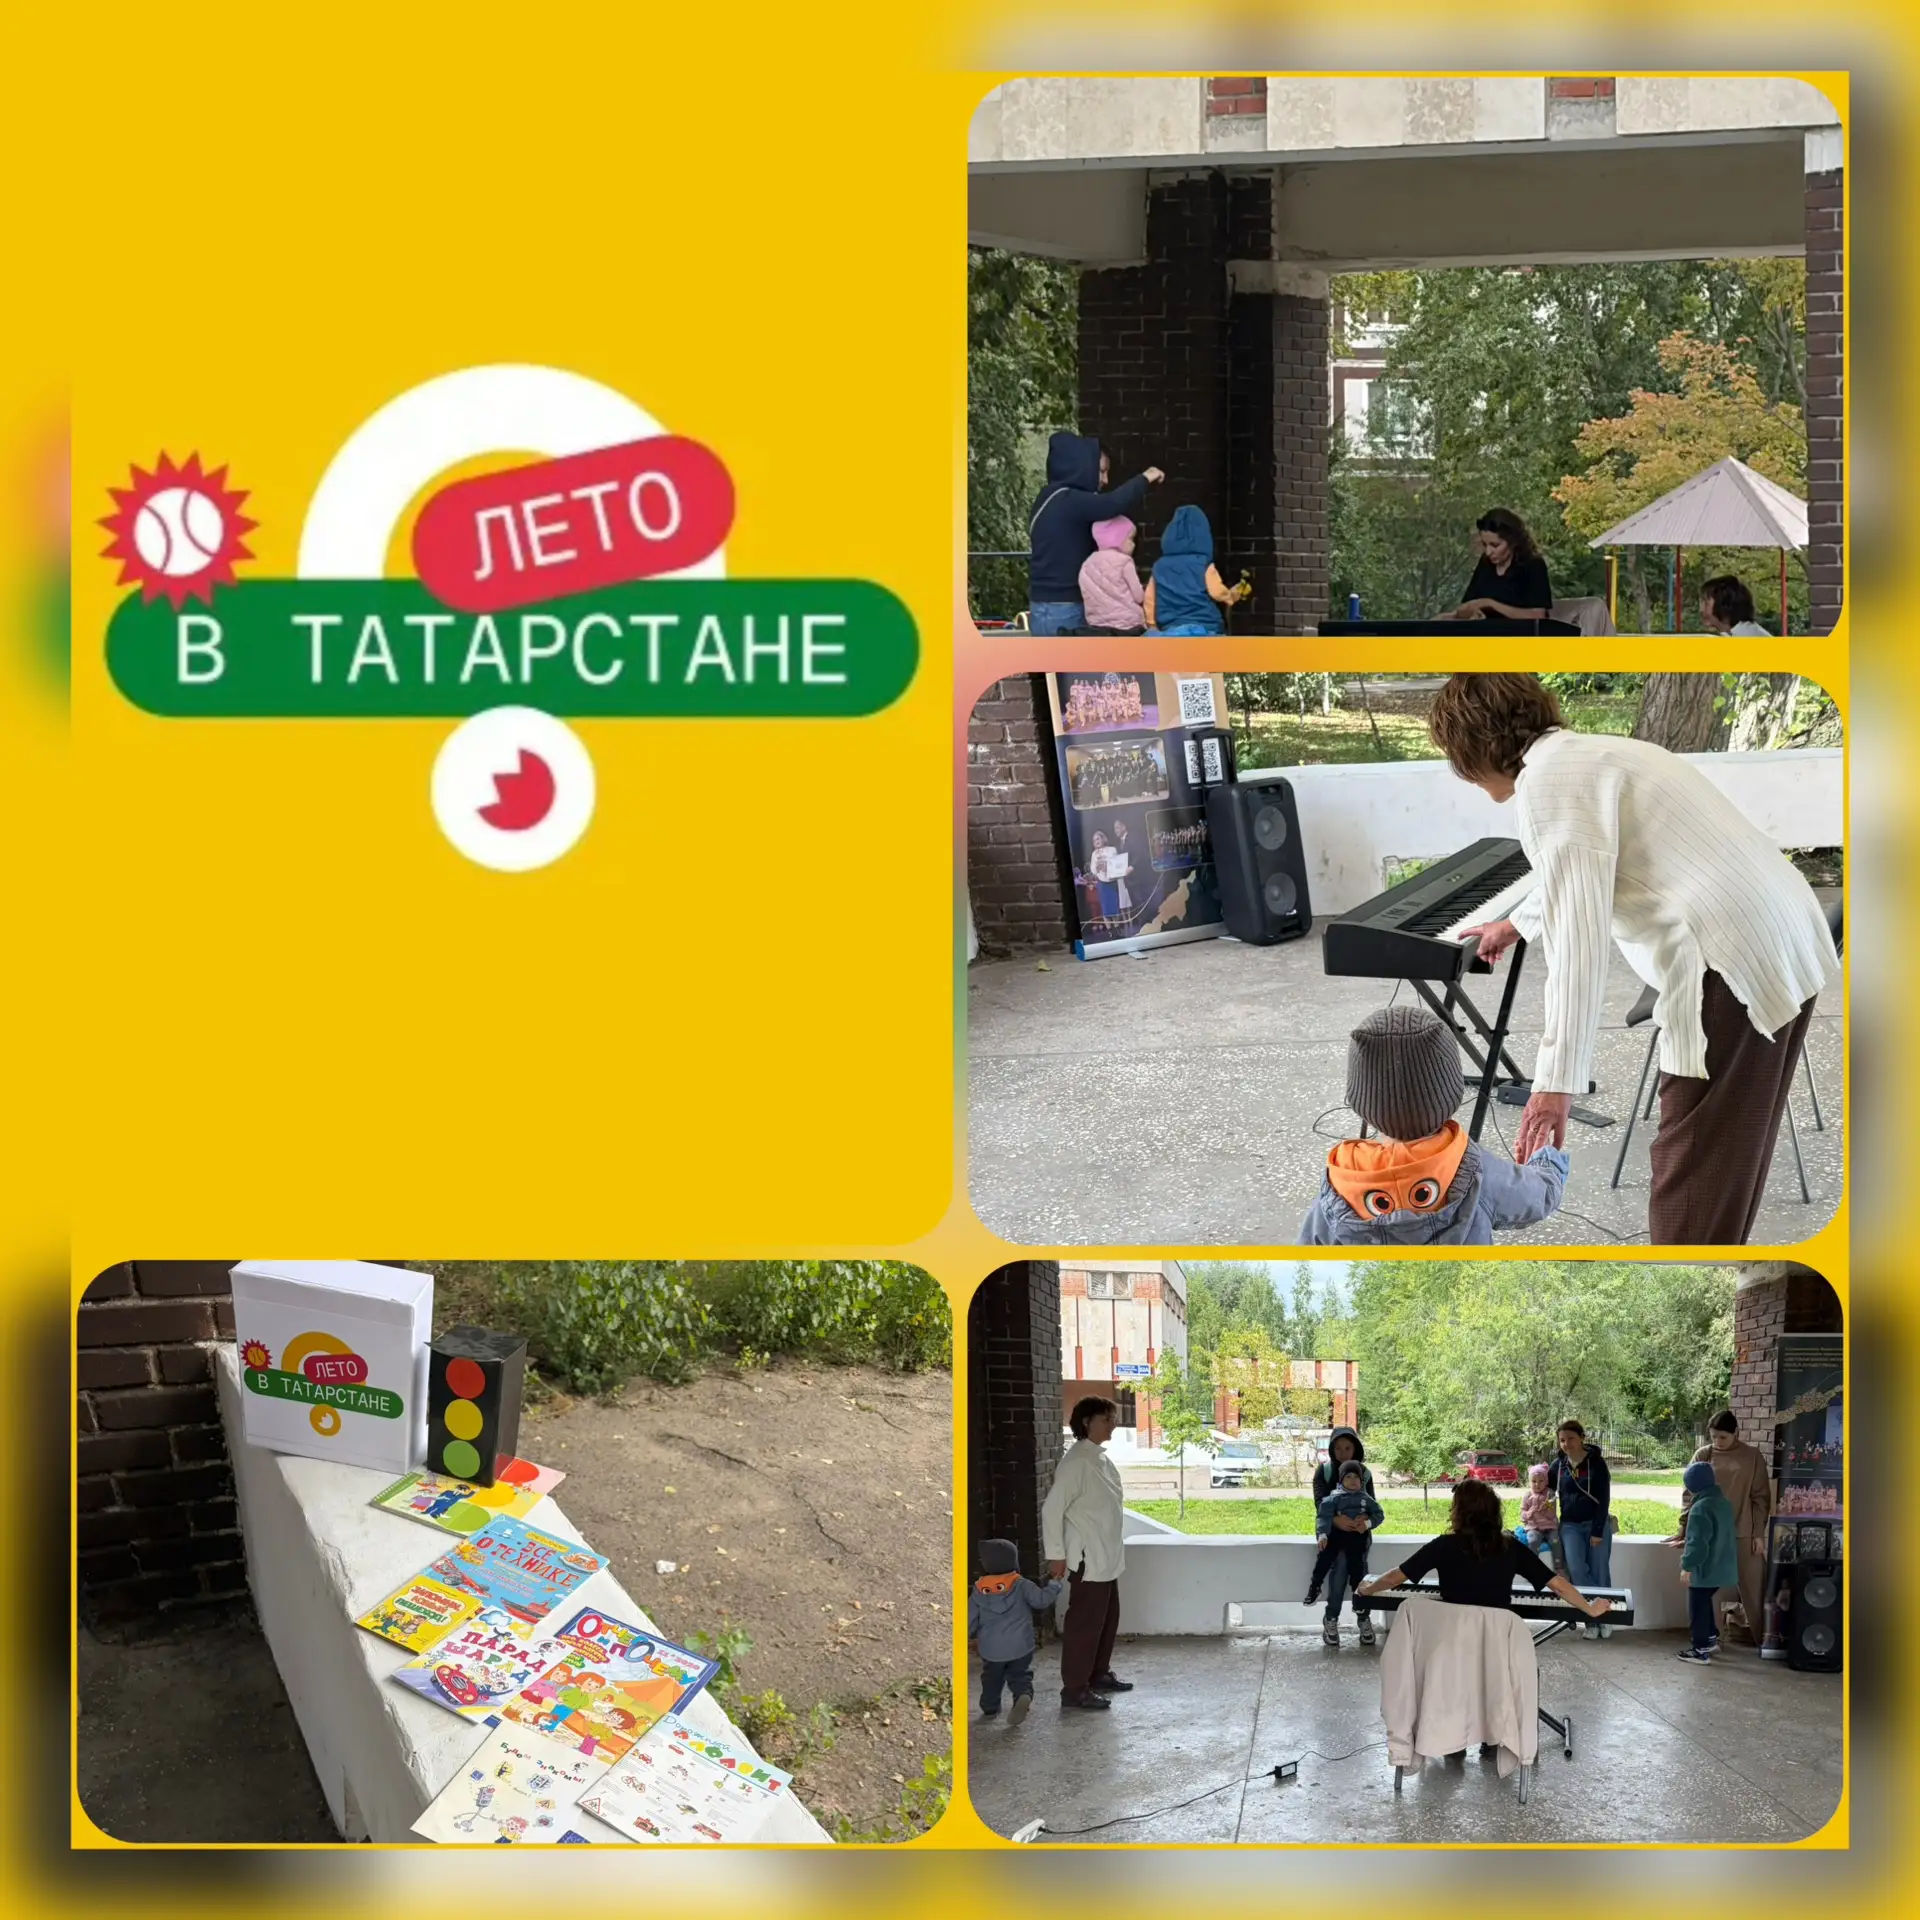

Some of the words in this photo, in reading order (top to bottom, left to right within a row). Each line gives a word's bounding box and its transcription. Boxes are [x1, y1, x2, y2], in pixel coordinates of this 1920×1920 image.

[315, 1360, 358, 1379] ЛЕТО
[257, 1373, 269, 1389] В
[280, 1377, 391, 1412] ТАТАРСТАНЕ
[476, 1537, 494, 1549] О
[491, 1543, 580, 1588] ТЕХНИКЕ
[442, 1641, 531, 1684] ШАРАД
[461, 1631, 547, 1673] ПАРАД
[664, 1715, 731, 1752] Дорожный
[500, 1742, 531, 1760] Будем
[536, 1760, 586, 1784] знакомы!
